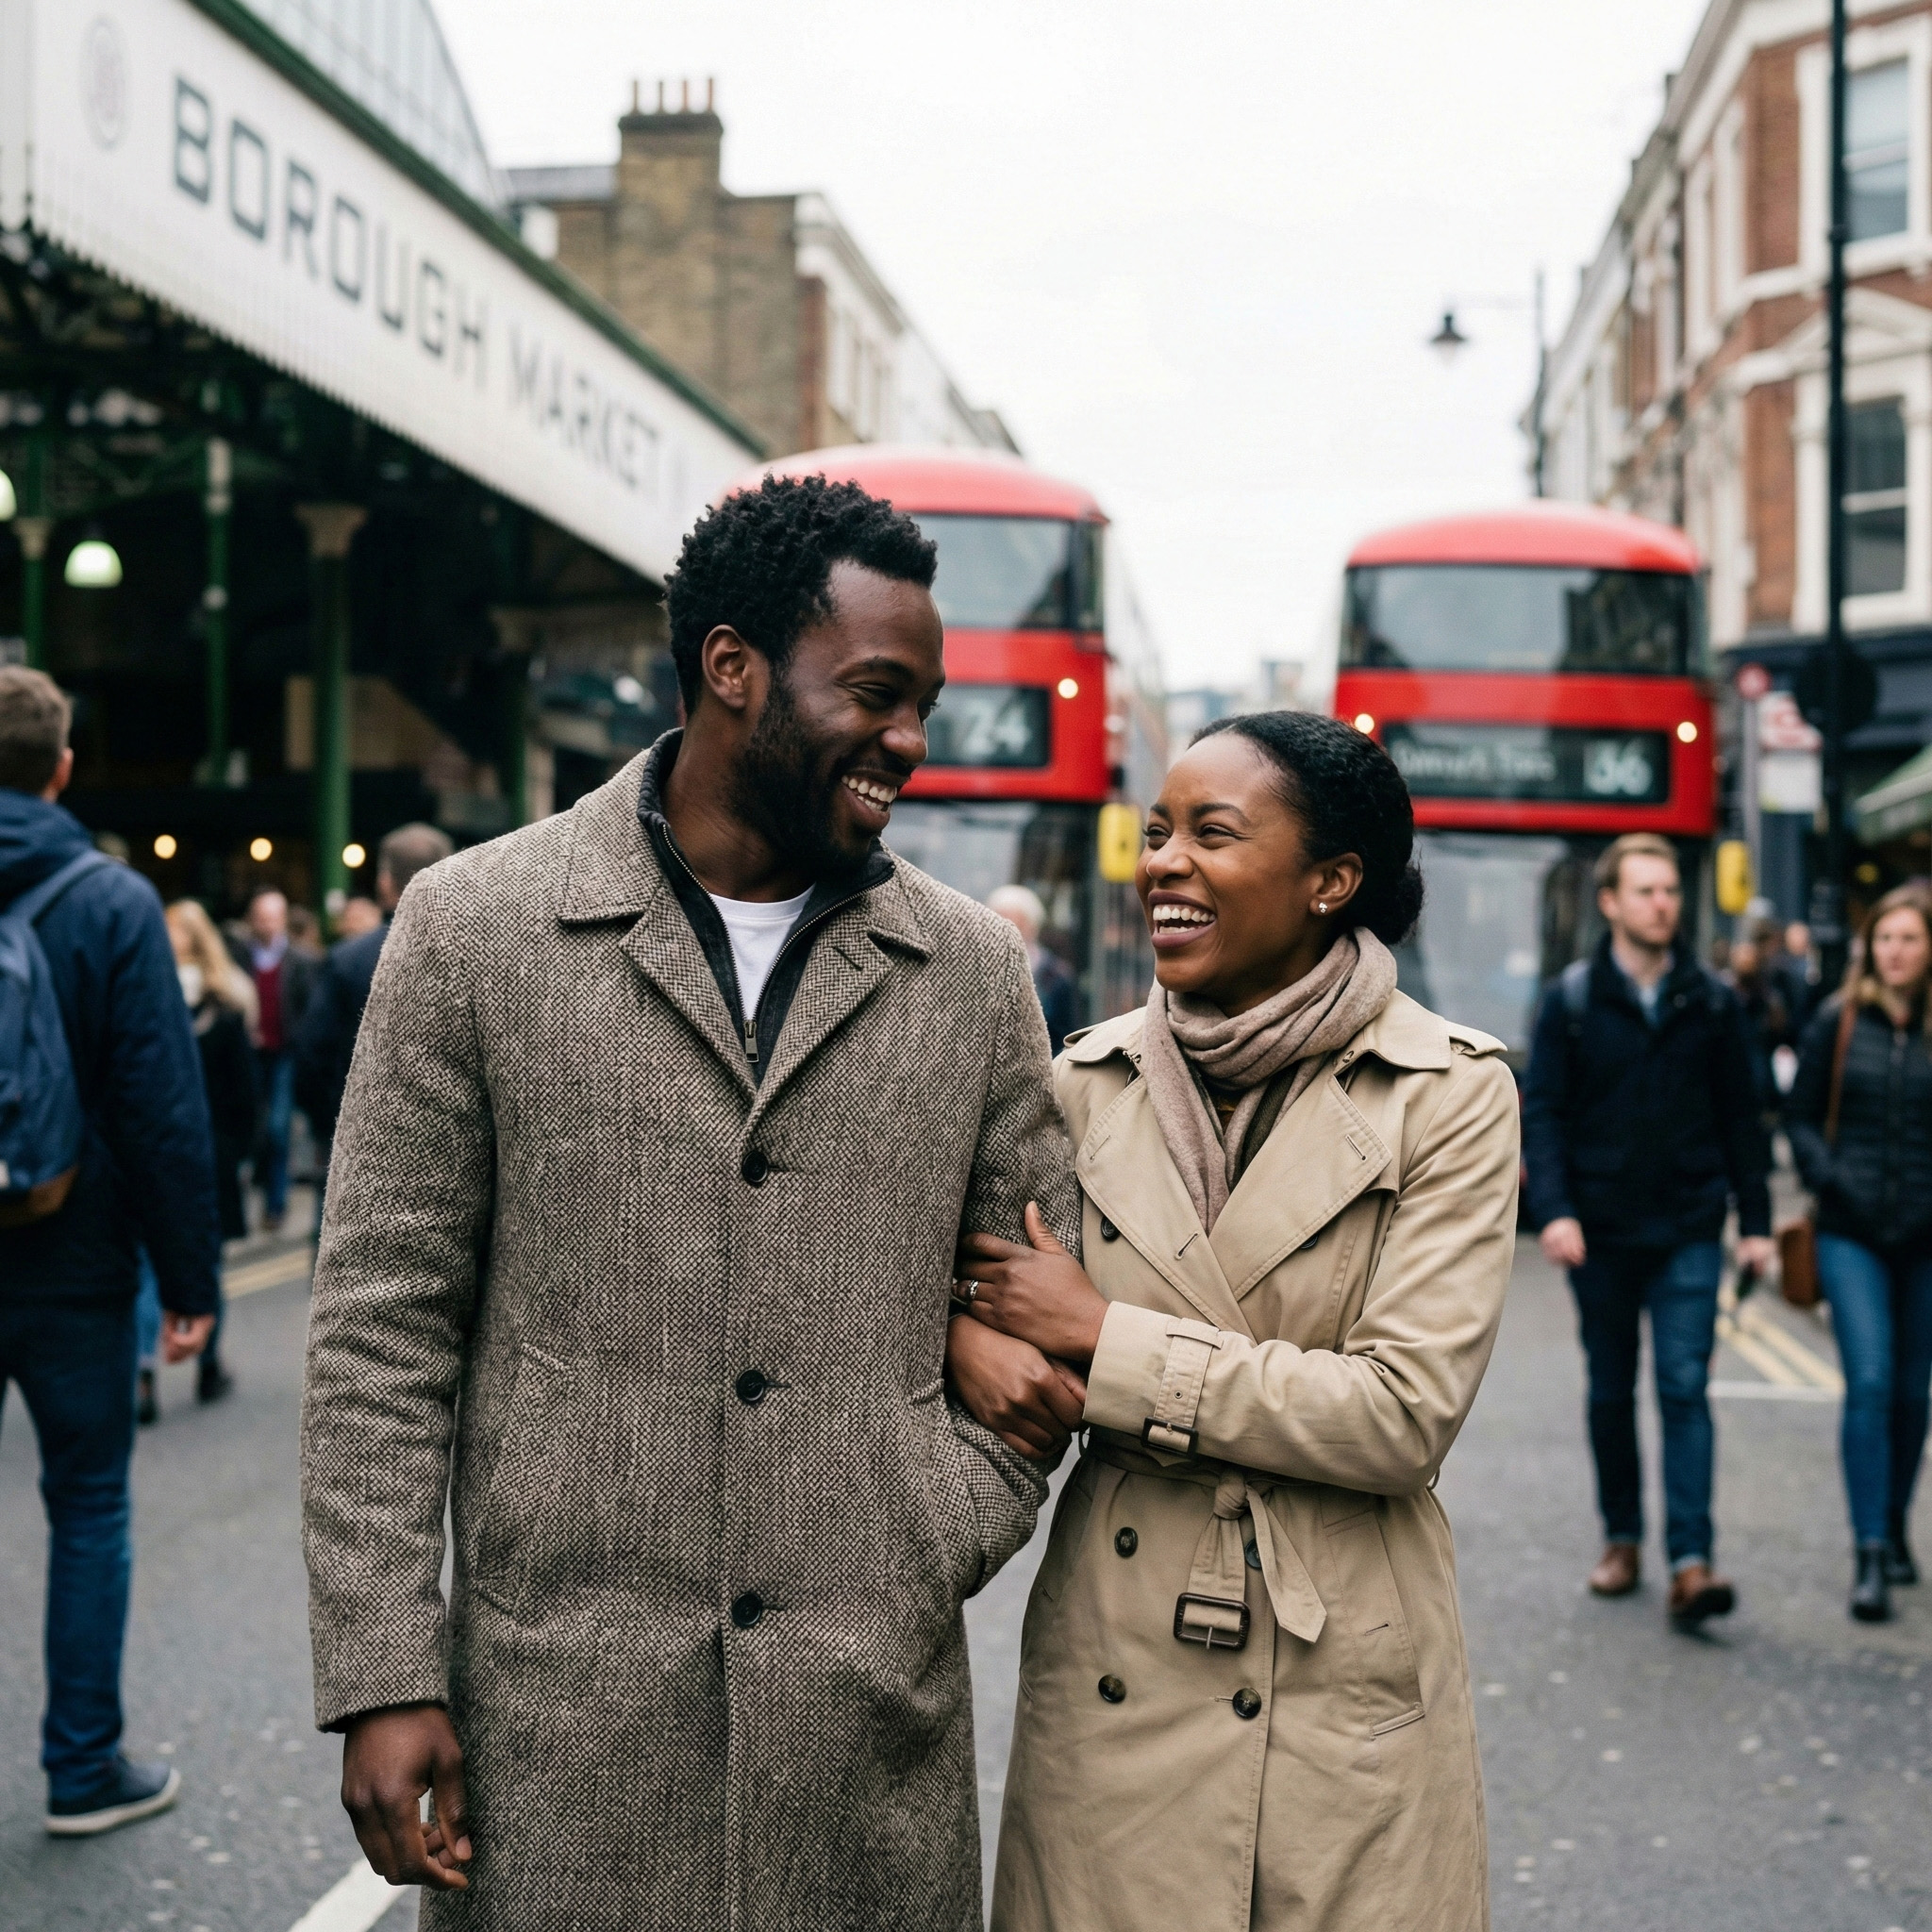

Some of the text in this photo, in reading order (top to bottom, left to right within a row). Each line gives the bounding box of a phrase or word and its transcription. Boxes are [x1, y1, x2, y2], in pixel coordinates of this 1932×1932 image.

[173, 75, 661, 501] BOROUGH MARKET
[959, 698, 1031, 760] 24
